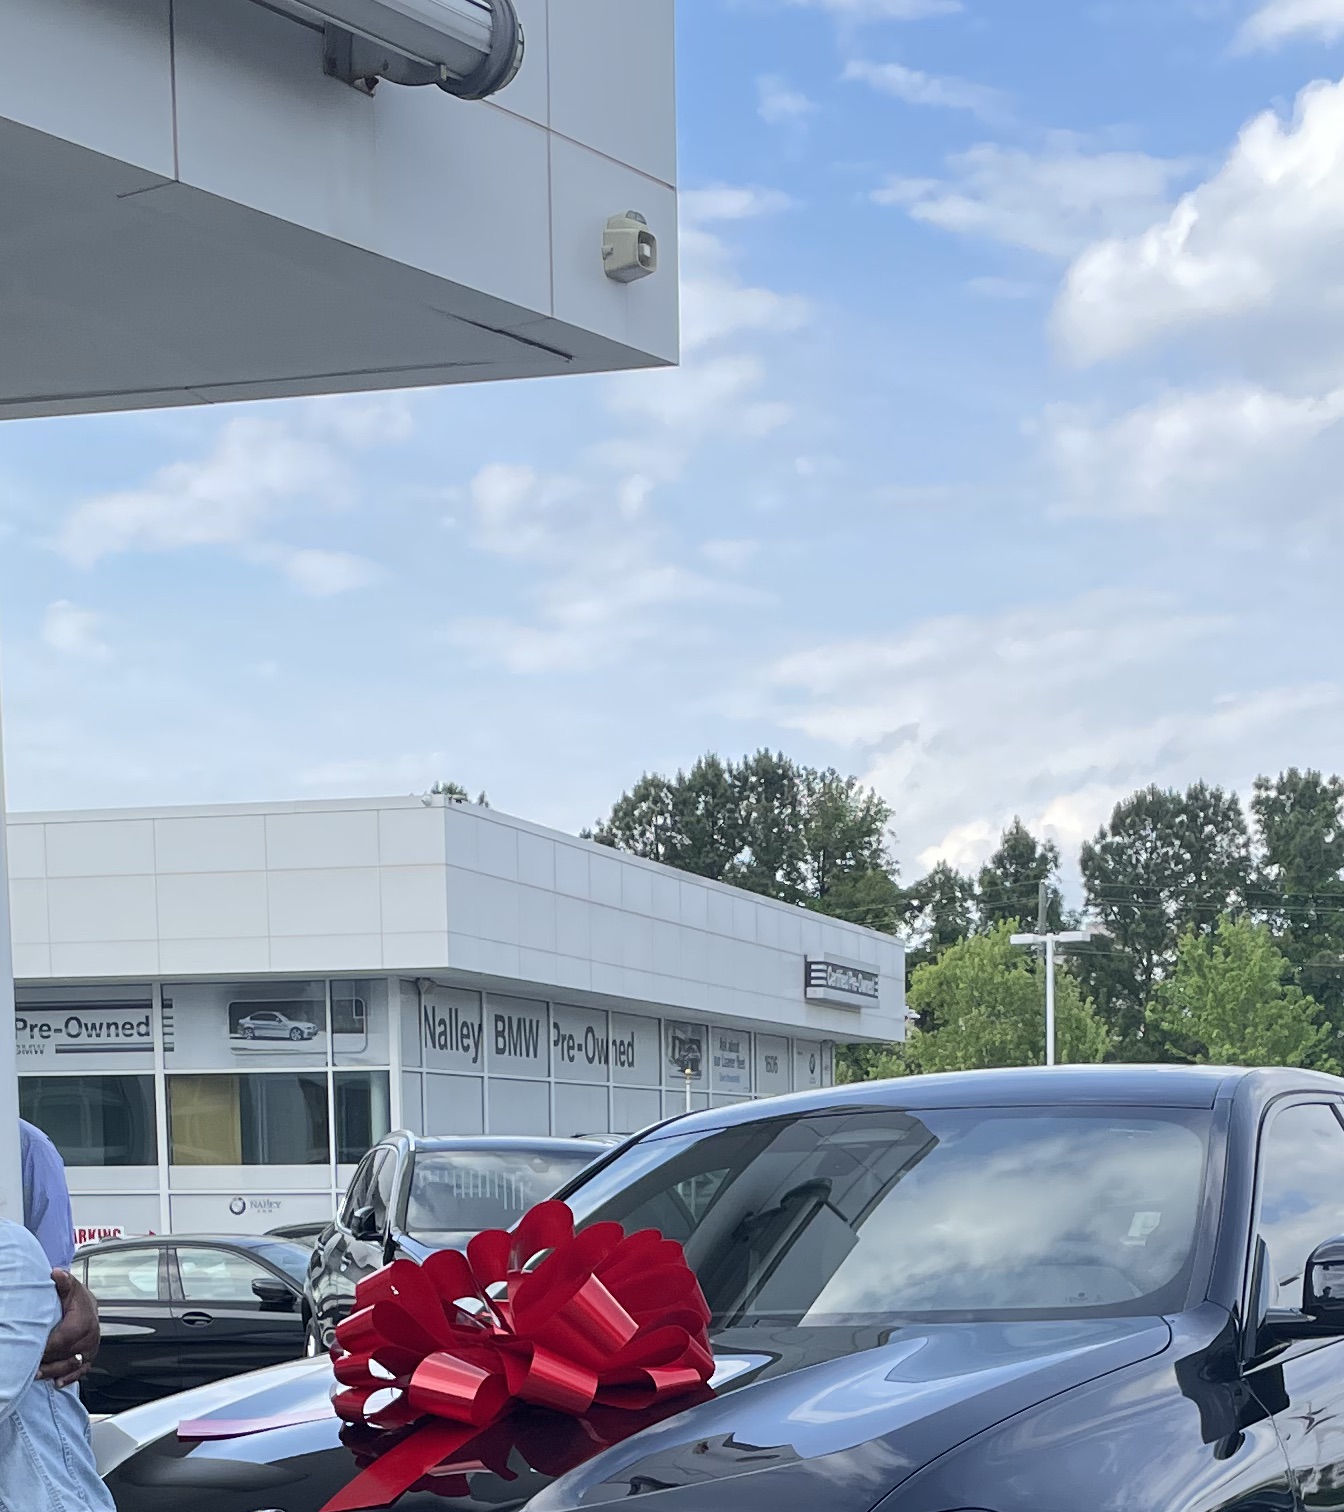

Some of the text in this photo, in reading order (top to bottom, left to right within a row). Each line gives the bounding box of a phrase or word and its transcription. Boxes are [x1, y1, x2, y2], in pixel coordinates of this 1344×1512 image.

[16, 1015, 151, 1040] Pre-Owned
[423, 1004, 635, 1068] Nalley BMW Pre-Owned
